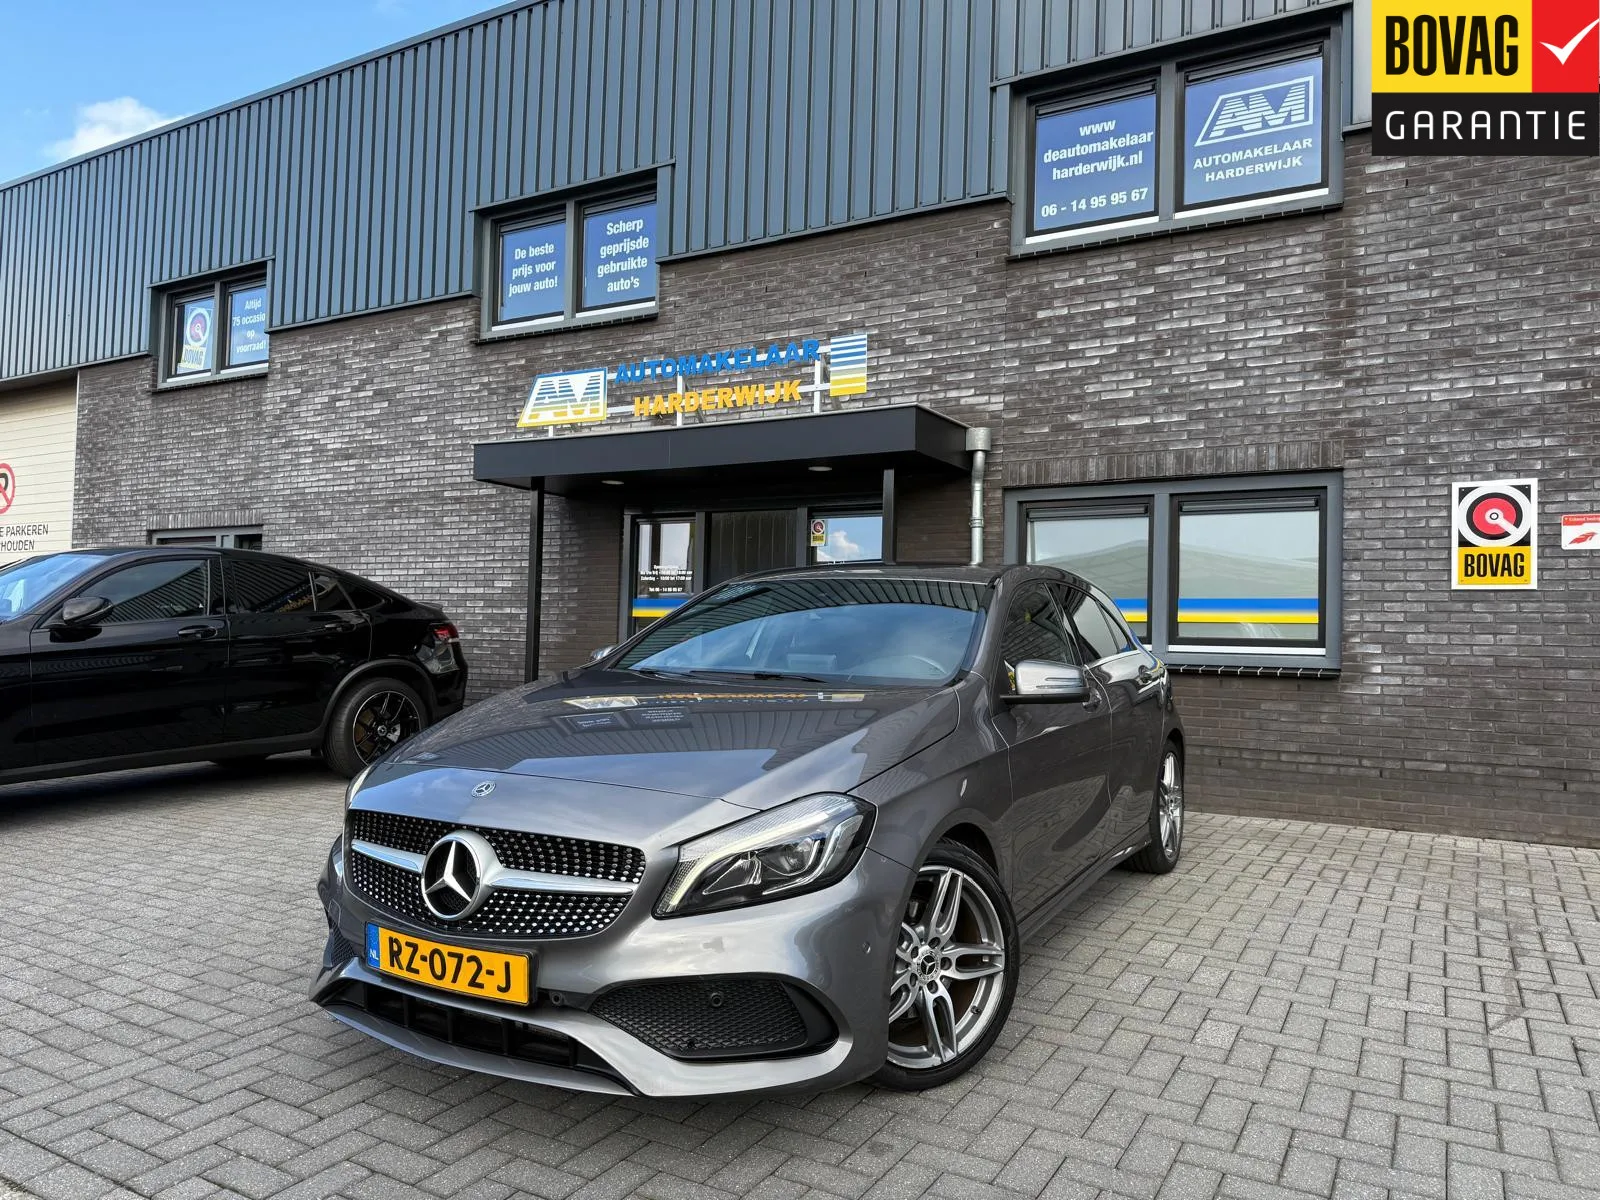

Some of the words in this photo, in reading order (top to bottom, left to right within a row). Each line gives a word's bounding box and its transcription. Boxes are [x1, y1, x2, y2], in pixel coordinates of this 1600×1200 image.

[1079, 119, 1116, 137] www
[1043, 130, 1154, 164] deautomakelaar
[1193, 138, 1313, 170] AUTOMAKELAAR
[1052, 151, 1143, 181] harderwijk.nl
[1205, 155, 1303, 183] HARDERWIJK
[1041, 203, 1057, 218] 06
[1071, 198, 1087, 212] 14
[1090, 194, 1106, 208] 95
[1110, 191, 1127, 205] 95
[1131, 187, 1149, 201] 67
[606, 218, 644, 236] Scherp
[514, 248, 527, 260] De
[529, 243, 555, 257] beste
[601, 236, 649, 258] geprijsde
[512, 263, 533, 280] prijs
[535, 260, 556, 273] voor
[597, 255, 648, 278] gebruikte
[508, 280, 532, 297] jouw
[533, 276, 558, 292] auto!
[607, 276, 640, 293] auto's
[245, 298, 261, 310] Altijd
[232, 316, 241, 327] 75
[242, 312, 265, 325] occasio
[247, 330, 255, 339] op
[237, 340, 266, 353] voorraad!
[615, 339, 820, 384] AUTOMAKELAAR
[633, 379, 802, 418] HARDERWIJK
[6, 524, 48, 536] PARKEREN
[1, 540, 34, 551] HOUDEN
[1464, 553, 1524, 577] BOVAG
[369, 948, 379, 960] NL
[388, 936, 512, 993] RZ-072-J
